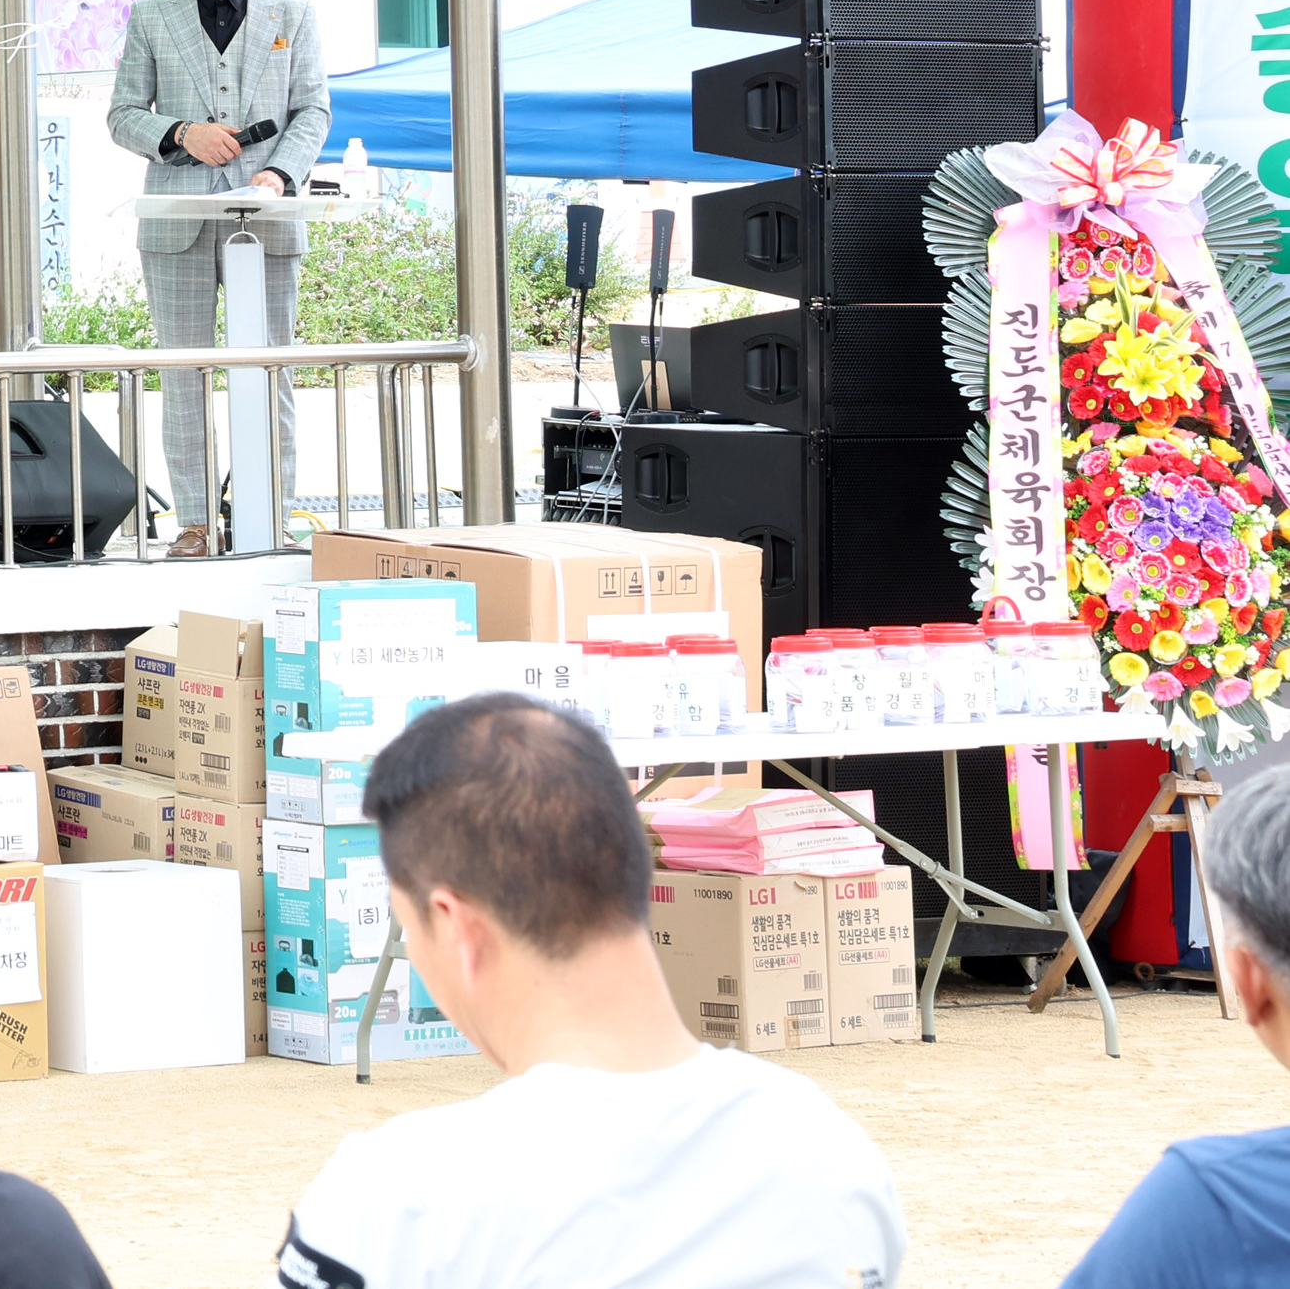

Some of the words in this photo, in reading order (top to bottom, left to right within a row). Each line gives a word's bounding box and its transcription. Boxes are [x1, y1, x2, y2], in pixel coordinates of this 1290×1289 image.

[999, 301, 1058, 605] 진도군체육회장
[380, 646, 445, 664] 세한농기계
[137, 679, 161, 695] 샤프란
[179, 680, 213, 697] LG생활건강
[179, 699, 196, 714] 자연퐁
[197, 702, 206, 714] 2X
[57, 807, 81, 824] 샤프란
[179, 827, 196, 843] 자연퐁
[197, 830, 207, 843] 2X
[693, 888, 733, 901] 11001890
[749, 888, 769, 906] LG
[835, 882, 856, 900] LG
[751, 914, 775, 933] 생활의
[776, 913, 792, 930] 품격
[837, 909, 862, 927] 생활의
[863, 907, 881, 925] 품격
[752, 931, 799, 952] 진심담은세트
[799, 930, 821, 946] 특1호
[838, 926, 887, 946] 진심담은세트
[888, 924, 911, 940] 특1호
[762, 1021, 777, 1037] 세트
[847, 1014, 863, 1030] 세트
